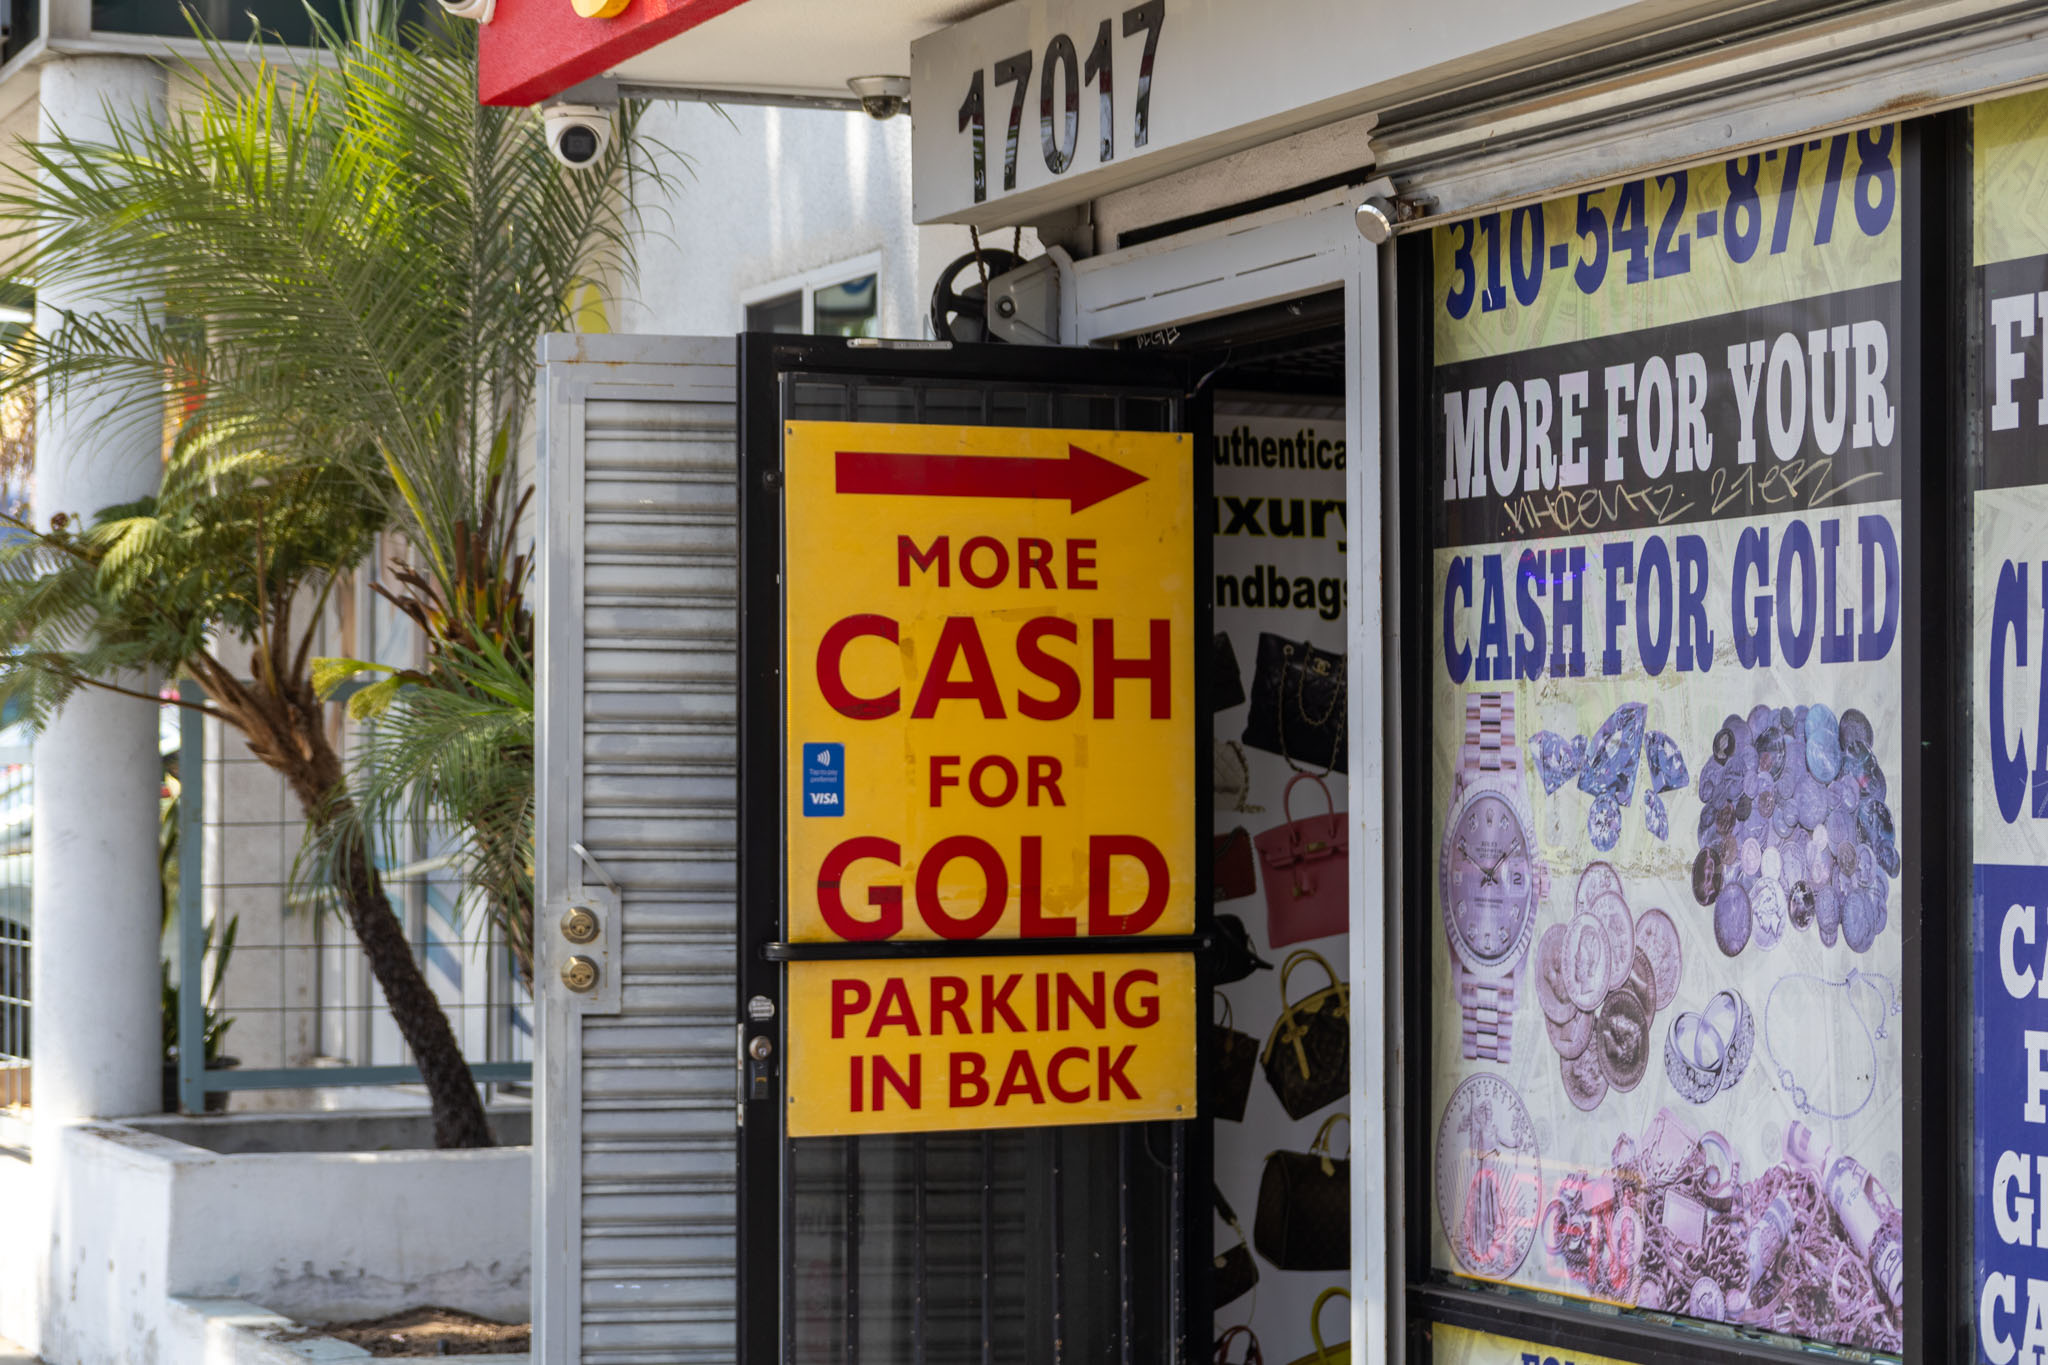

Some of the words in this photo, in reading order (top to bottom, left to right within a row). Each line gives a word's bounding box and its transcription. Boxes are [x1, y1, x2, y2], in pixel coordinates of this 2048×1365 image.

[958, 0, 1165, 204] 17017
[1445, 122, 1897, 321] 310-542-8778
[1443, 368, 1590, 500] MORE
[1604, 350, 1713, 481] FOR
[1727, 318, 1896, 465] YOUR
[897, 535, 1099, 591] MORE
[1443, 545, 1587, 685] CASH
[1602, 533, 1714, 677] FOR
[1731, 513, 1901, 671] GOLD
[816, 613, 1172, 722] CASH
[809, 792, 839, 805] VISA
[929, 754, 1067, 809] FOR
[816, 834, 1172, 943] GOLD
[831, 967, 1161, 1040] PARKING
[850, 1053, 922, 1113] IN
[949, 1044, 1143, 1109] BACK
